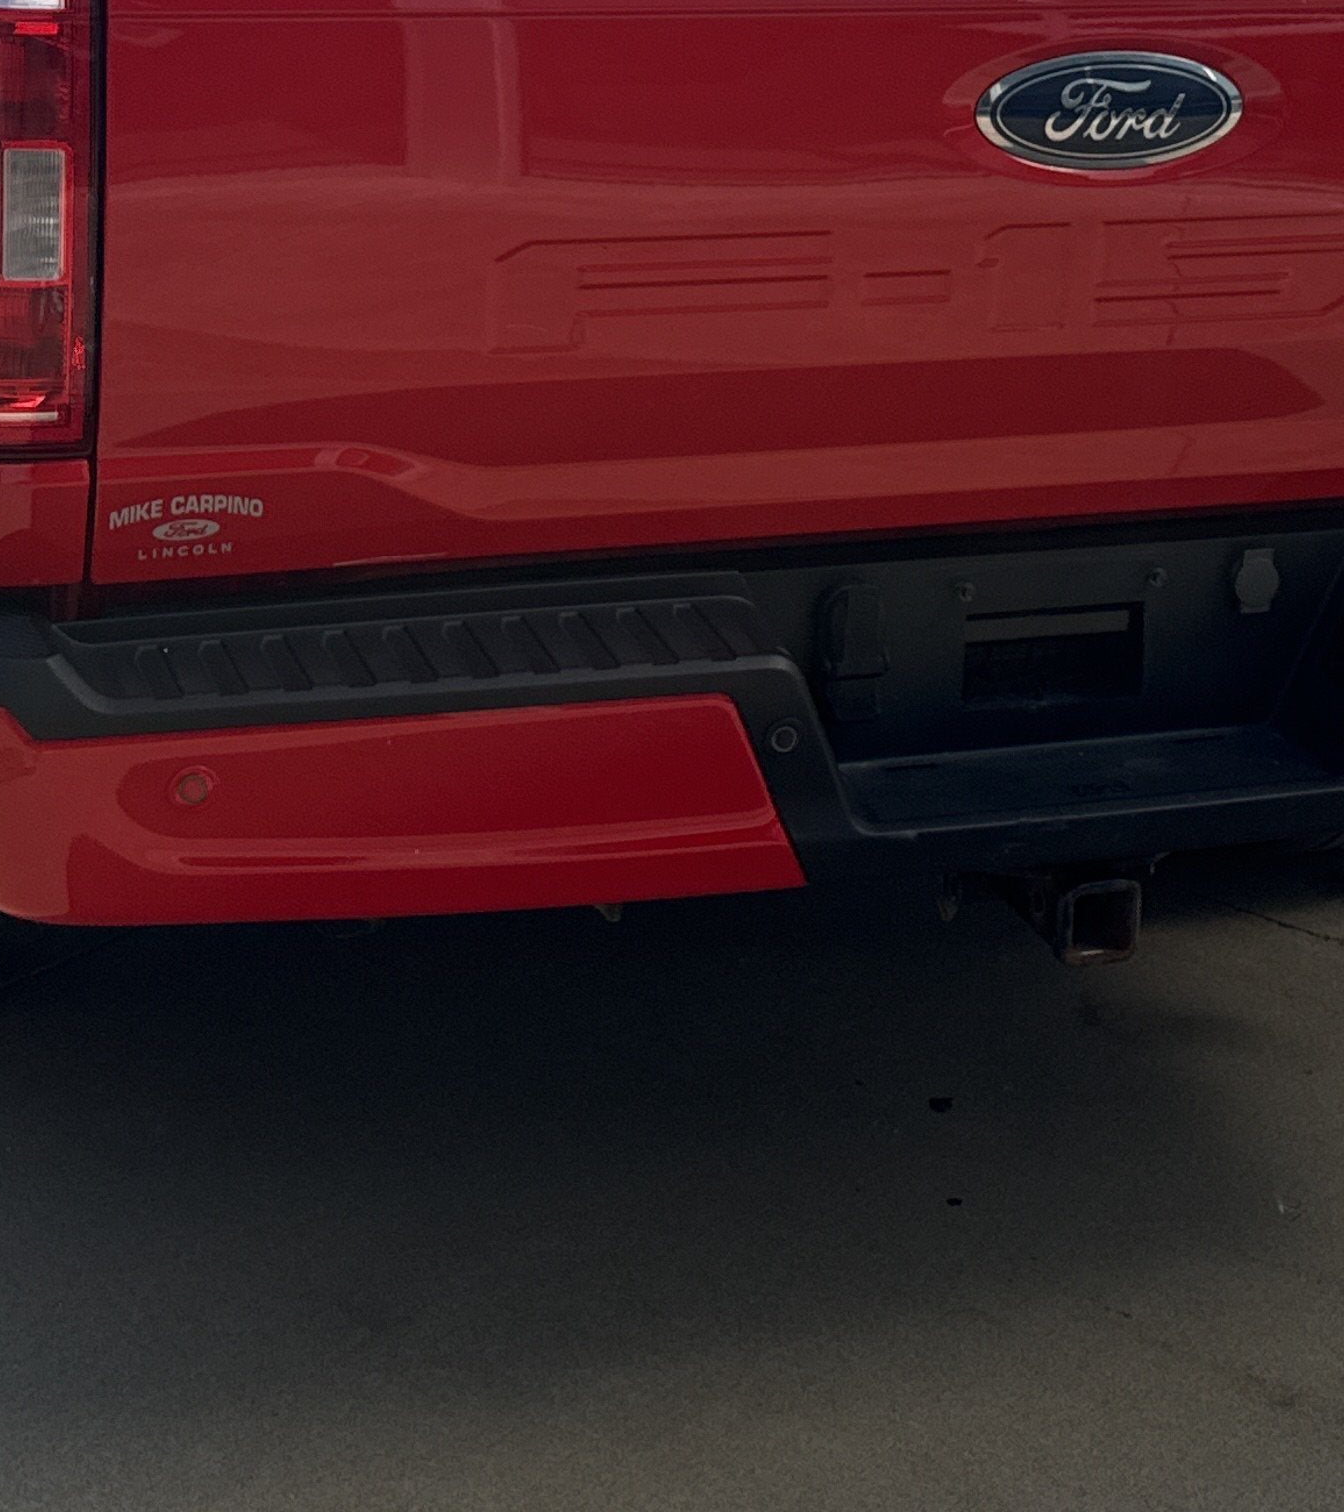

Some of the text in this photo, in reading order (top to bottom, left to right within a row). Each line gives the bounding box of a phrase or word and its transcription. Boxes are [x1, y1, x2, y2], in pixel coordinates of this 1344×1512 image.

[1045, 77, 1186, 143] Ford
[109, 494, 264, 530] MIKE CARPINO
[163, 521, 209, 538] Ford
[137, 541, 234, 561] LINCOLN
